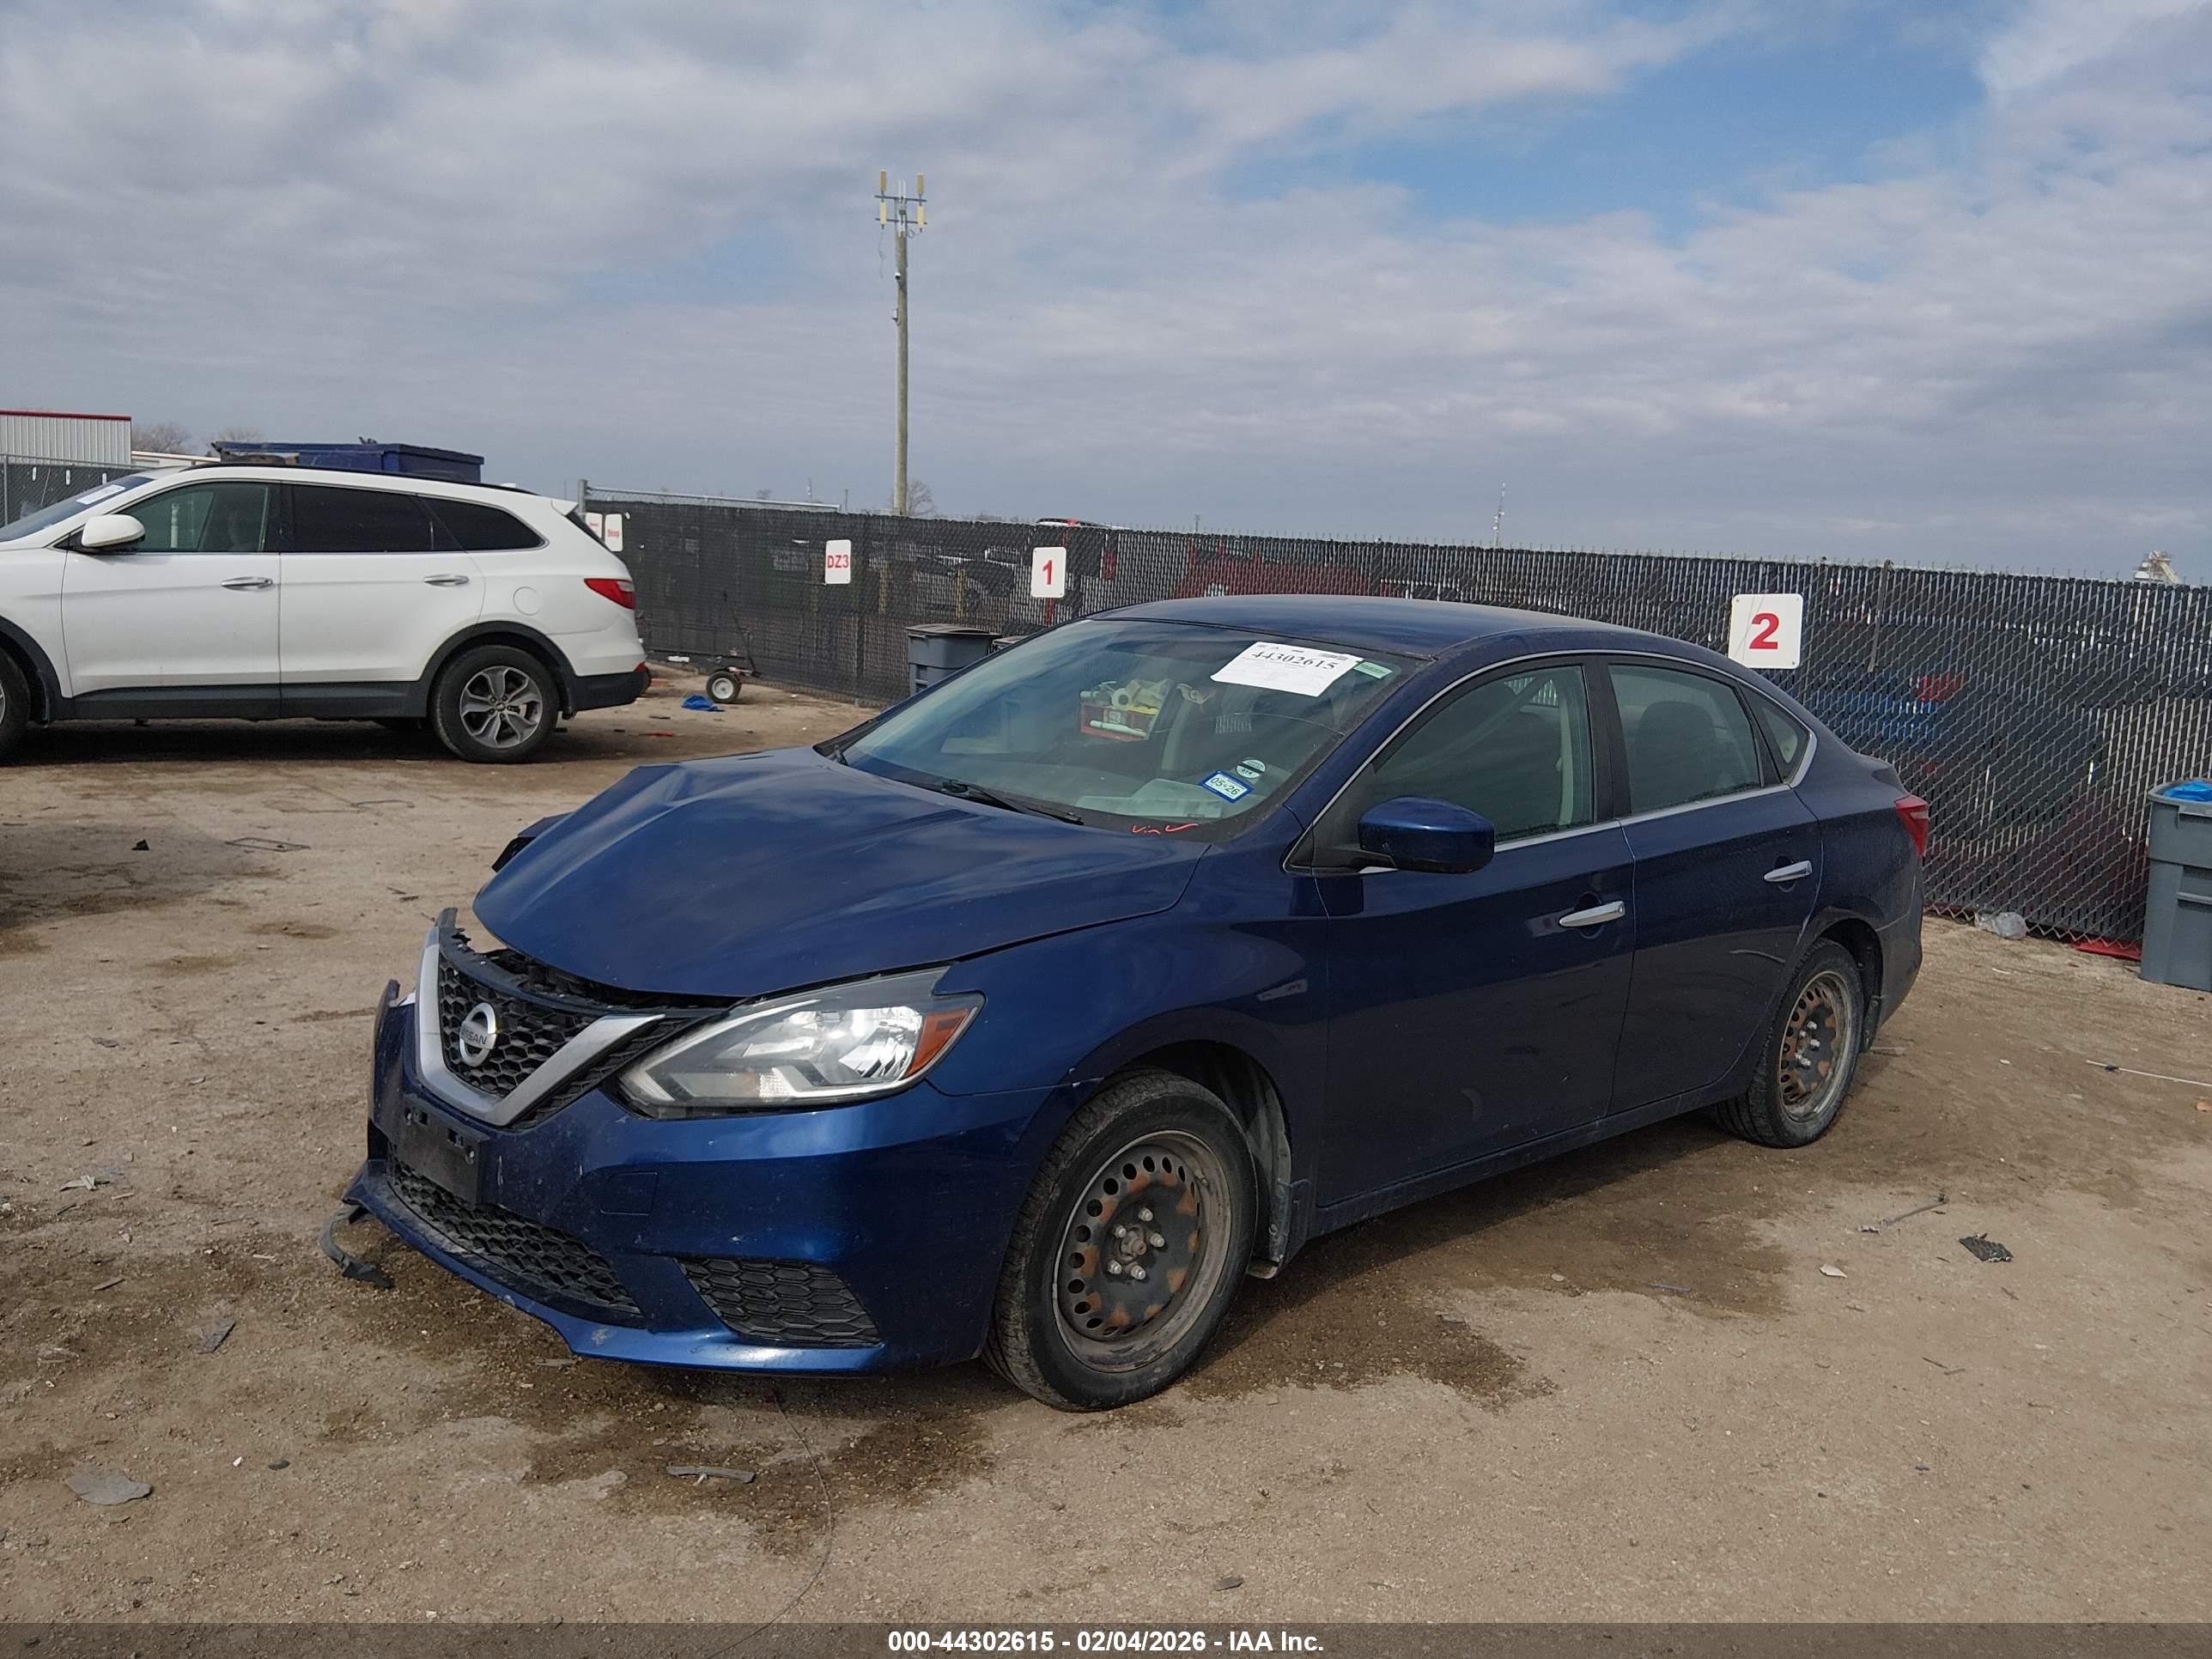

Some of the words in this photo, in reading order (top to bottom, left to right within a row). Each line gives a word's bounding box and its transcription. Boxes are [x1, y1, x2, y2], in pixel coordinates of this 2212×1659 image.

[827, 554, 849, 568] DZ3
[1042, 559, 1053, 586] 1
[1748, 612, 1780, 650] 2
[1250, 650, 1340, 670] 44302615
[460, 1029, 488, 1045] SAN
